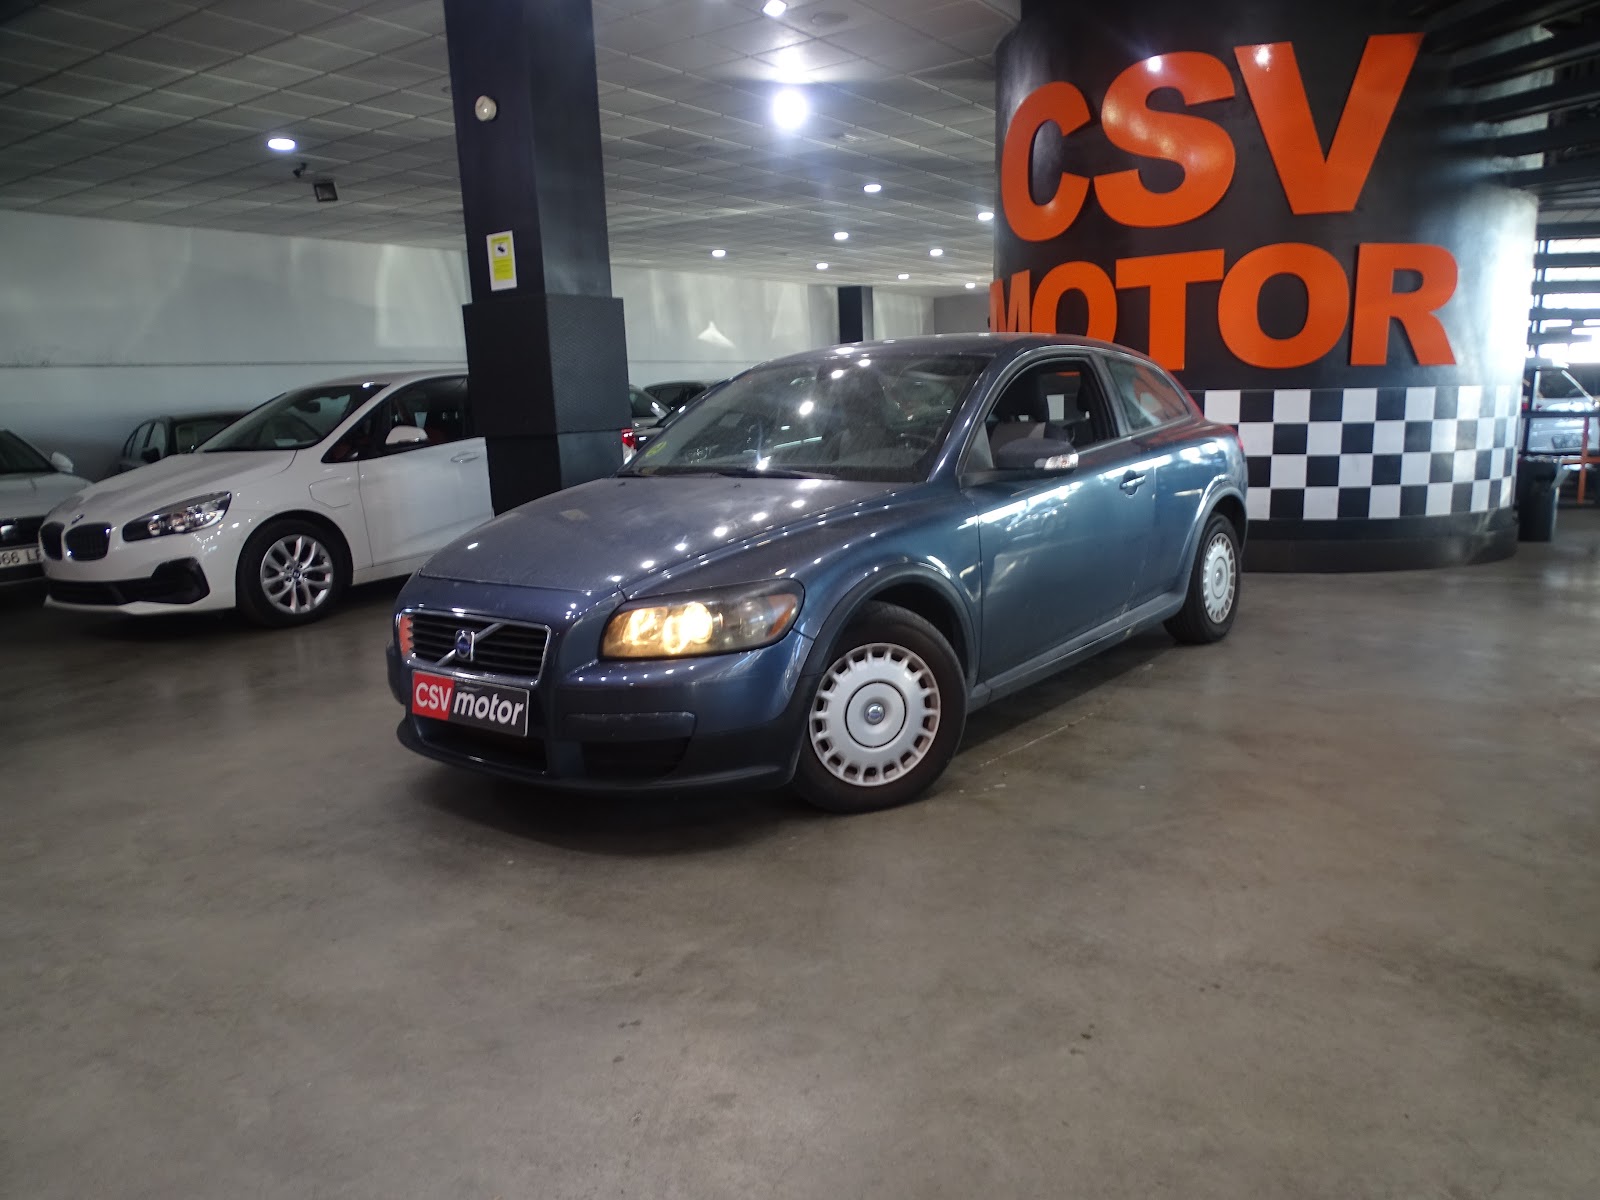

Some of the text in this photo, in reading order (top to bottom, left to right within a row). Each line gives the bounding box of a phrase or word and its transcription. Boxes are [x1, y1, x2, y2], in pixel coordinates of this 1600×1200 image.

[1001, 32, 1426, 242] CSV
[989, 242, 1459, 371] MOTOR
[415, 682, 524, 726] CSV motor
